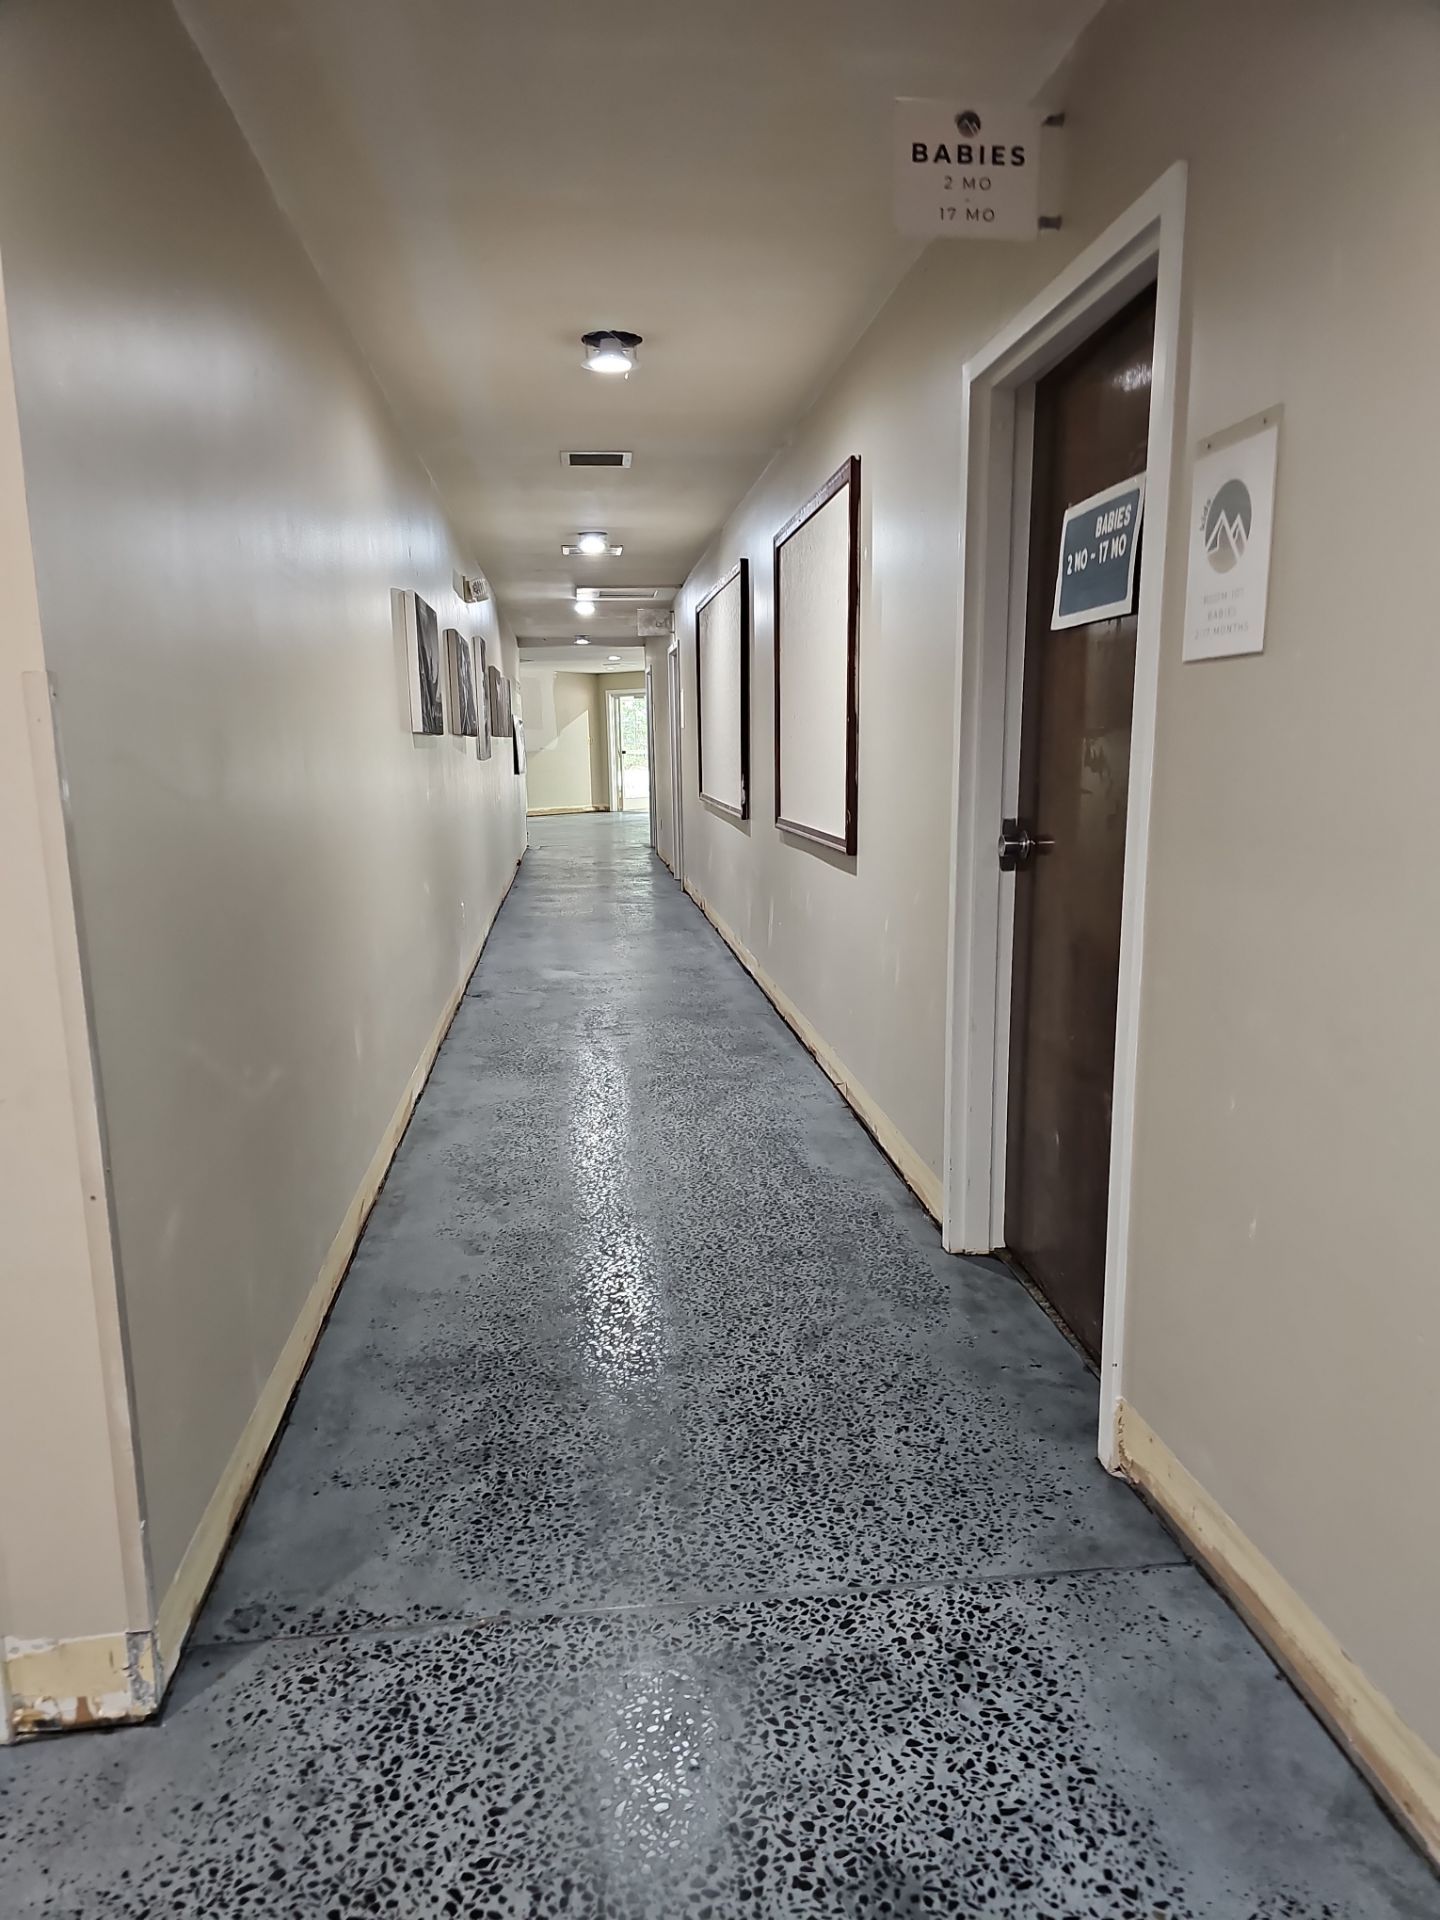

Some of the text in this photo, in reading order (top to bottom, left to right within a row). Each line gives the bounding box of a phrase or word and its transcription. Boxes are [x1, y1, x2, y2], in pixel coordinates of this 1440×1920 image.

[911, 143, 1025, 167] BABIES
[944, 175, 992, 191] 2 MO
[939, 206, 996, 222] 17 MO
[1095, 504, 1132, 538] BABIES
[1066, 554, 1073, 575] 2
[1074, 547, 1088, 571] MO
[1099, 540, 1110, 564] 17
[1110, 534, 1127, 560] MO
